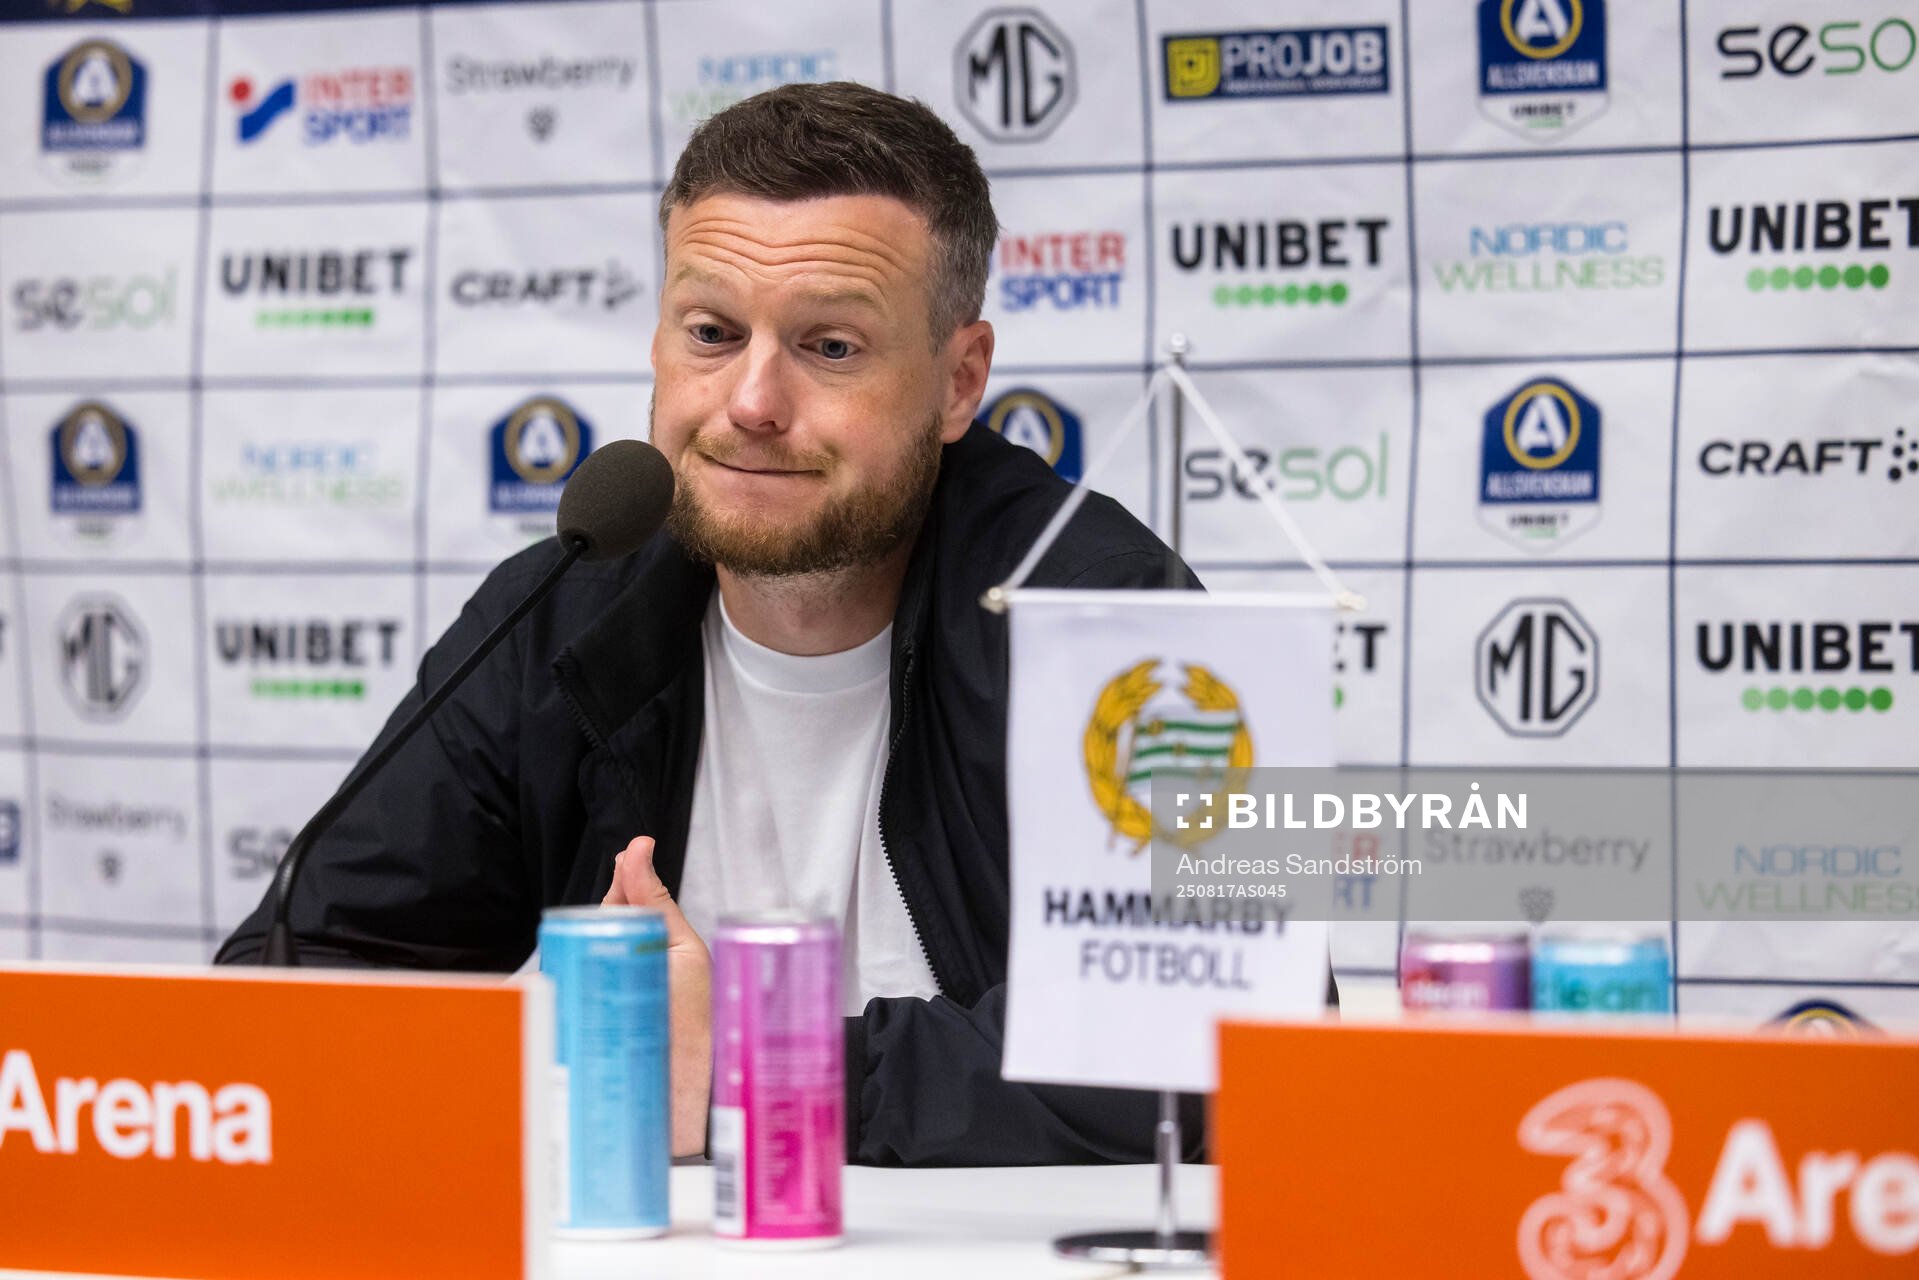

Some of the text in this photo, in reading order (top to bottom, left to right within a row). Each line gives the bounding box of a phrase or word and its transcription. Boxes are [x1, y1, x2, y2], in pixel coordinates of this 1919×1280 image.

[447, 54, 638, 95] Strawberry
[968, 22, 1068, 130] MG
[1222, 32, 1383, 77] PROJOB
[304, 68, 414, 106] INTER
[304, 106, 412, 145] SPORT
[1171, 218, 1390, 271] UNIBET
[1469, 222, 1628, 257] NORDIC
[1708, 198, 1919, 254] UNIBET
[219, 246, 416, 297] UNIBET
[1001, 231, 1127, 270] INTER
[449, 271, 597, 305] CRAFT
[1000, 271, 1122, 312] SPORT
[1432, 256, 1666, 294] WELLNESS
[1516, 393, 1570, 453] A
[1184, 431, 1390, 501] sesol
[1699, 440, 1882, 477] CRAFT
[215, 618, 401, 666] UNIBET
[1488, 612, 1588, 724] MG
[1424, 825, 1650, 872] Strawberry
[1733, 843, 1902, 877] NORDIC
[1043, 886, 1293, 936] HAMMARBY
[1696, 878, 1919, 915] WELLNES
[1080, 938, 1252, 991] FOTBOLL
[0, 1049, 272, 1165] Arena
